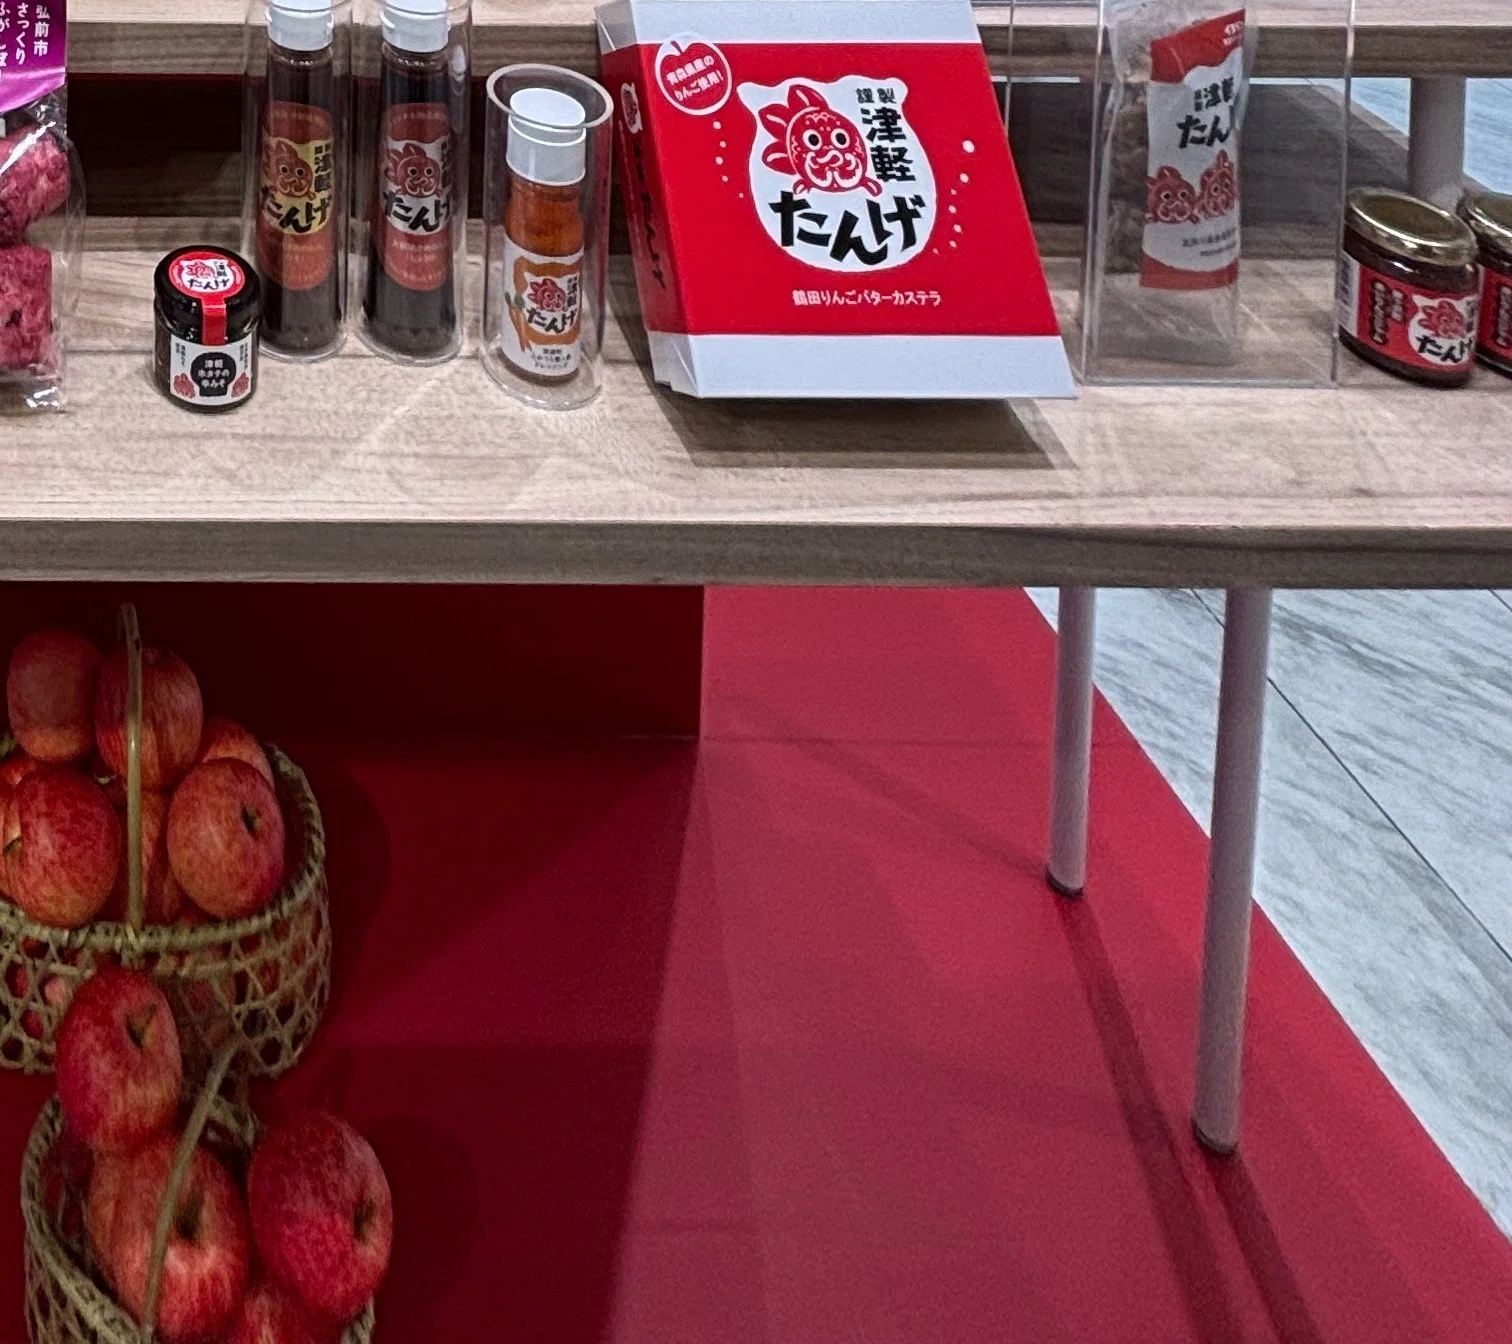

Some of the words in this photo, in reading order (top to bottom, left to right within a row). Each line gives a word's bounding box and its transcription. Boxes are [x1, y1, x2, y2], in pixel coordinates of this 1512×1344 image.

[14, 1, 29, 65] さっくり
[32, 4, 50, 57] 弘前市
[855, 87, 898, 105] 謹製
[861, 106, 917, 183] 津軽
[768, 190, 926, 266] たんげ
[526, 307, 578, 334] たんげ
[791, 289, 941, 307] 鶴田りんごバターカステラ
